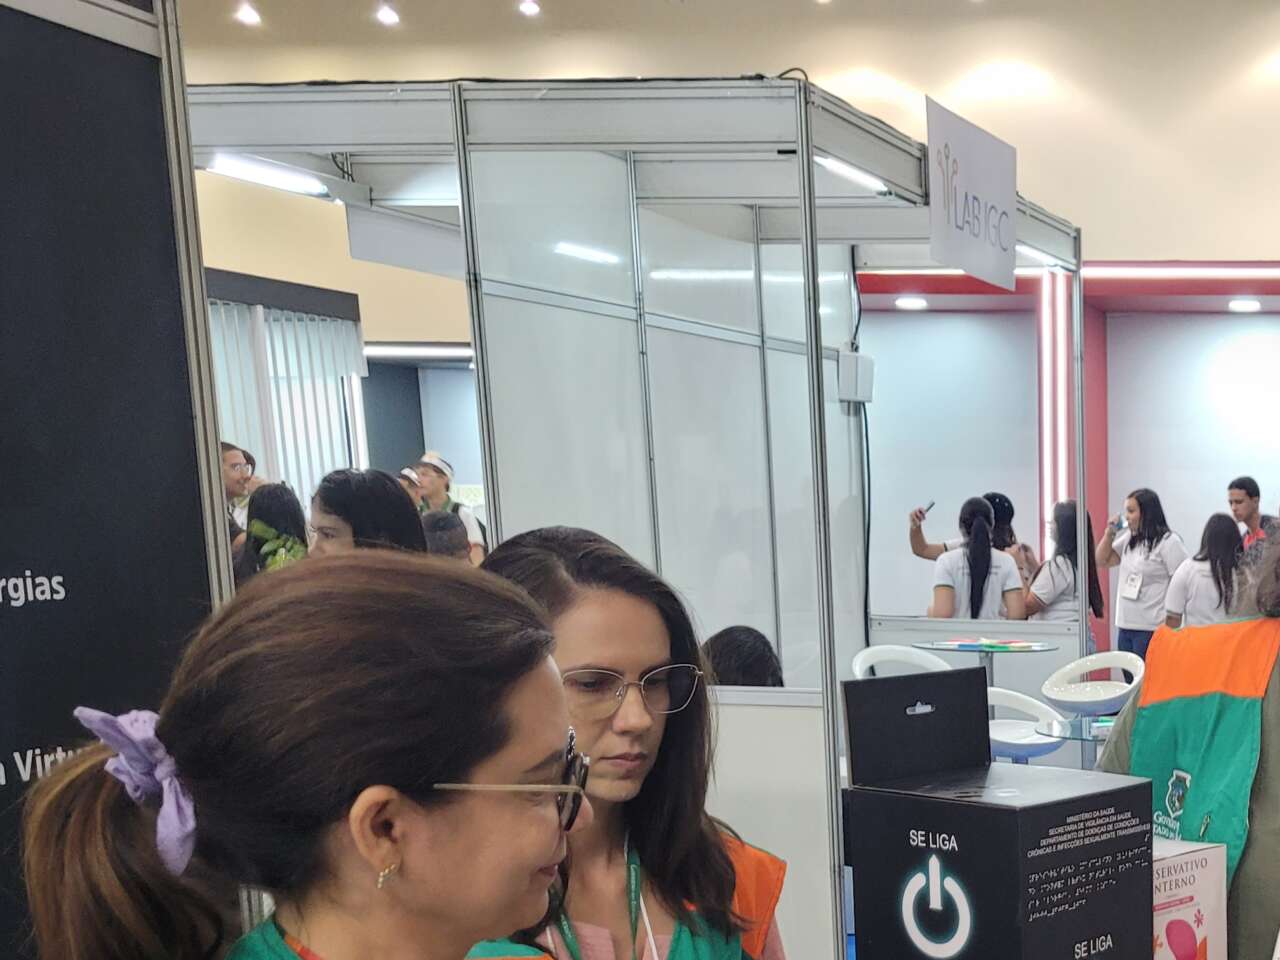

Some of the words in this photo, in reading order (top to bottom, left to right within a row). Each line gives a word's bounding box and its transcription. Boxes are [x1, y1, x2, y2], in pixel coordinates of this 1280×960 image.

[909, 829, 926, 847] SE
[929, 832, 958, 851] LIGA
[1153, 857, 1208, 880] SERVATIVO
[1074, 940, 1088, 960] SE
[1091, 934, 1113, 953] LIGA
